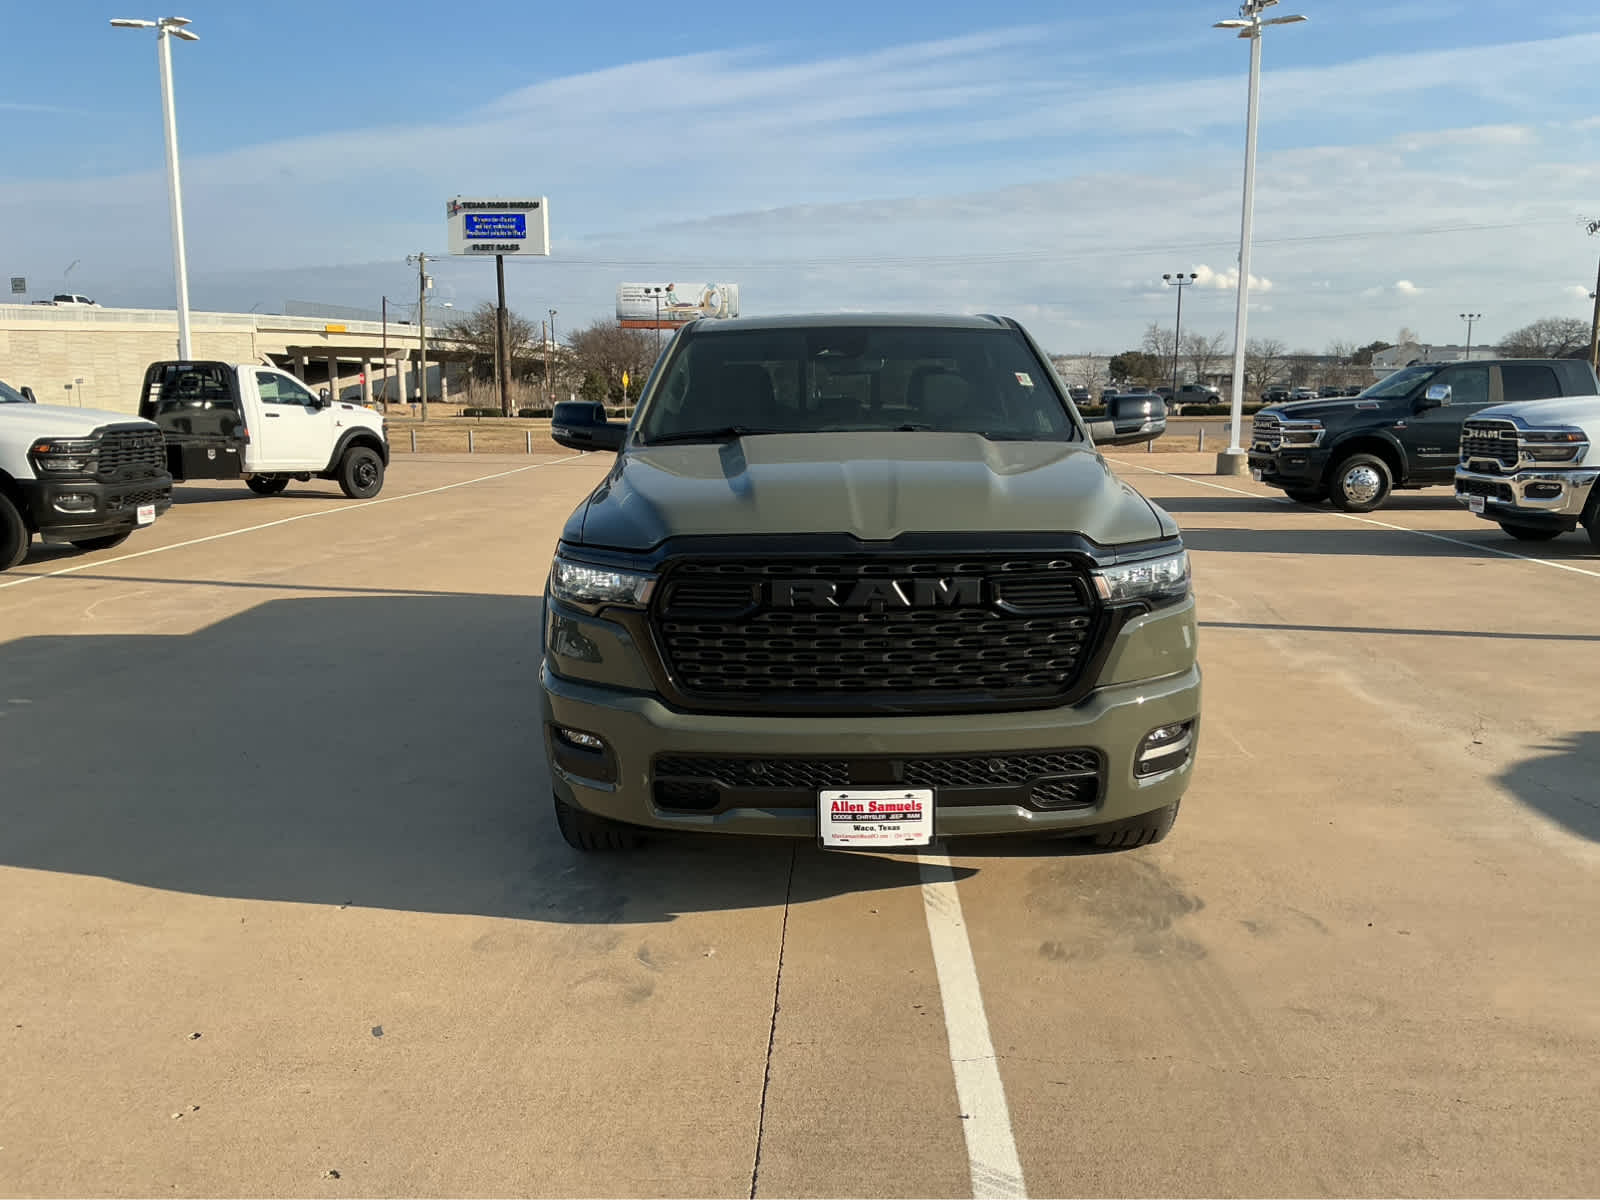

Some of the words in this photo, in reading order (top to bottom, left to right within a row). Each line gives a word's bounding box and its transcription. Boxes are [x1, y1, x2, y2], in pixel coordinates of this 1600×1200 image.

[1470, 430, 1499, 438] RAM
[771, 578, 981, 607] RAM
[831, 800, 864, 812] Allen
[868, 800, 922, 812] Samuels
